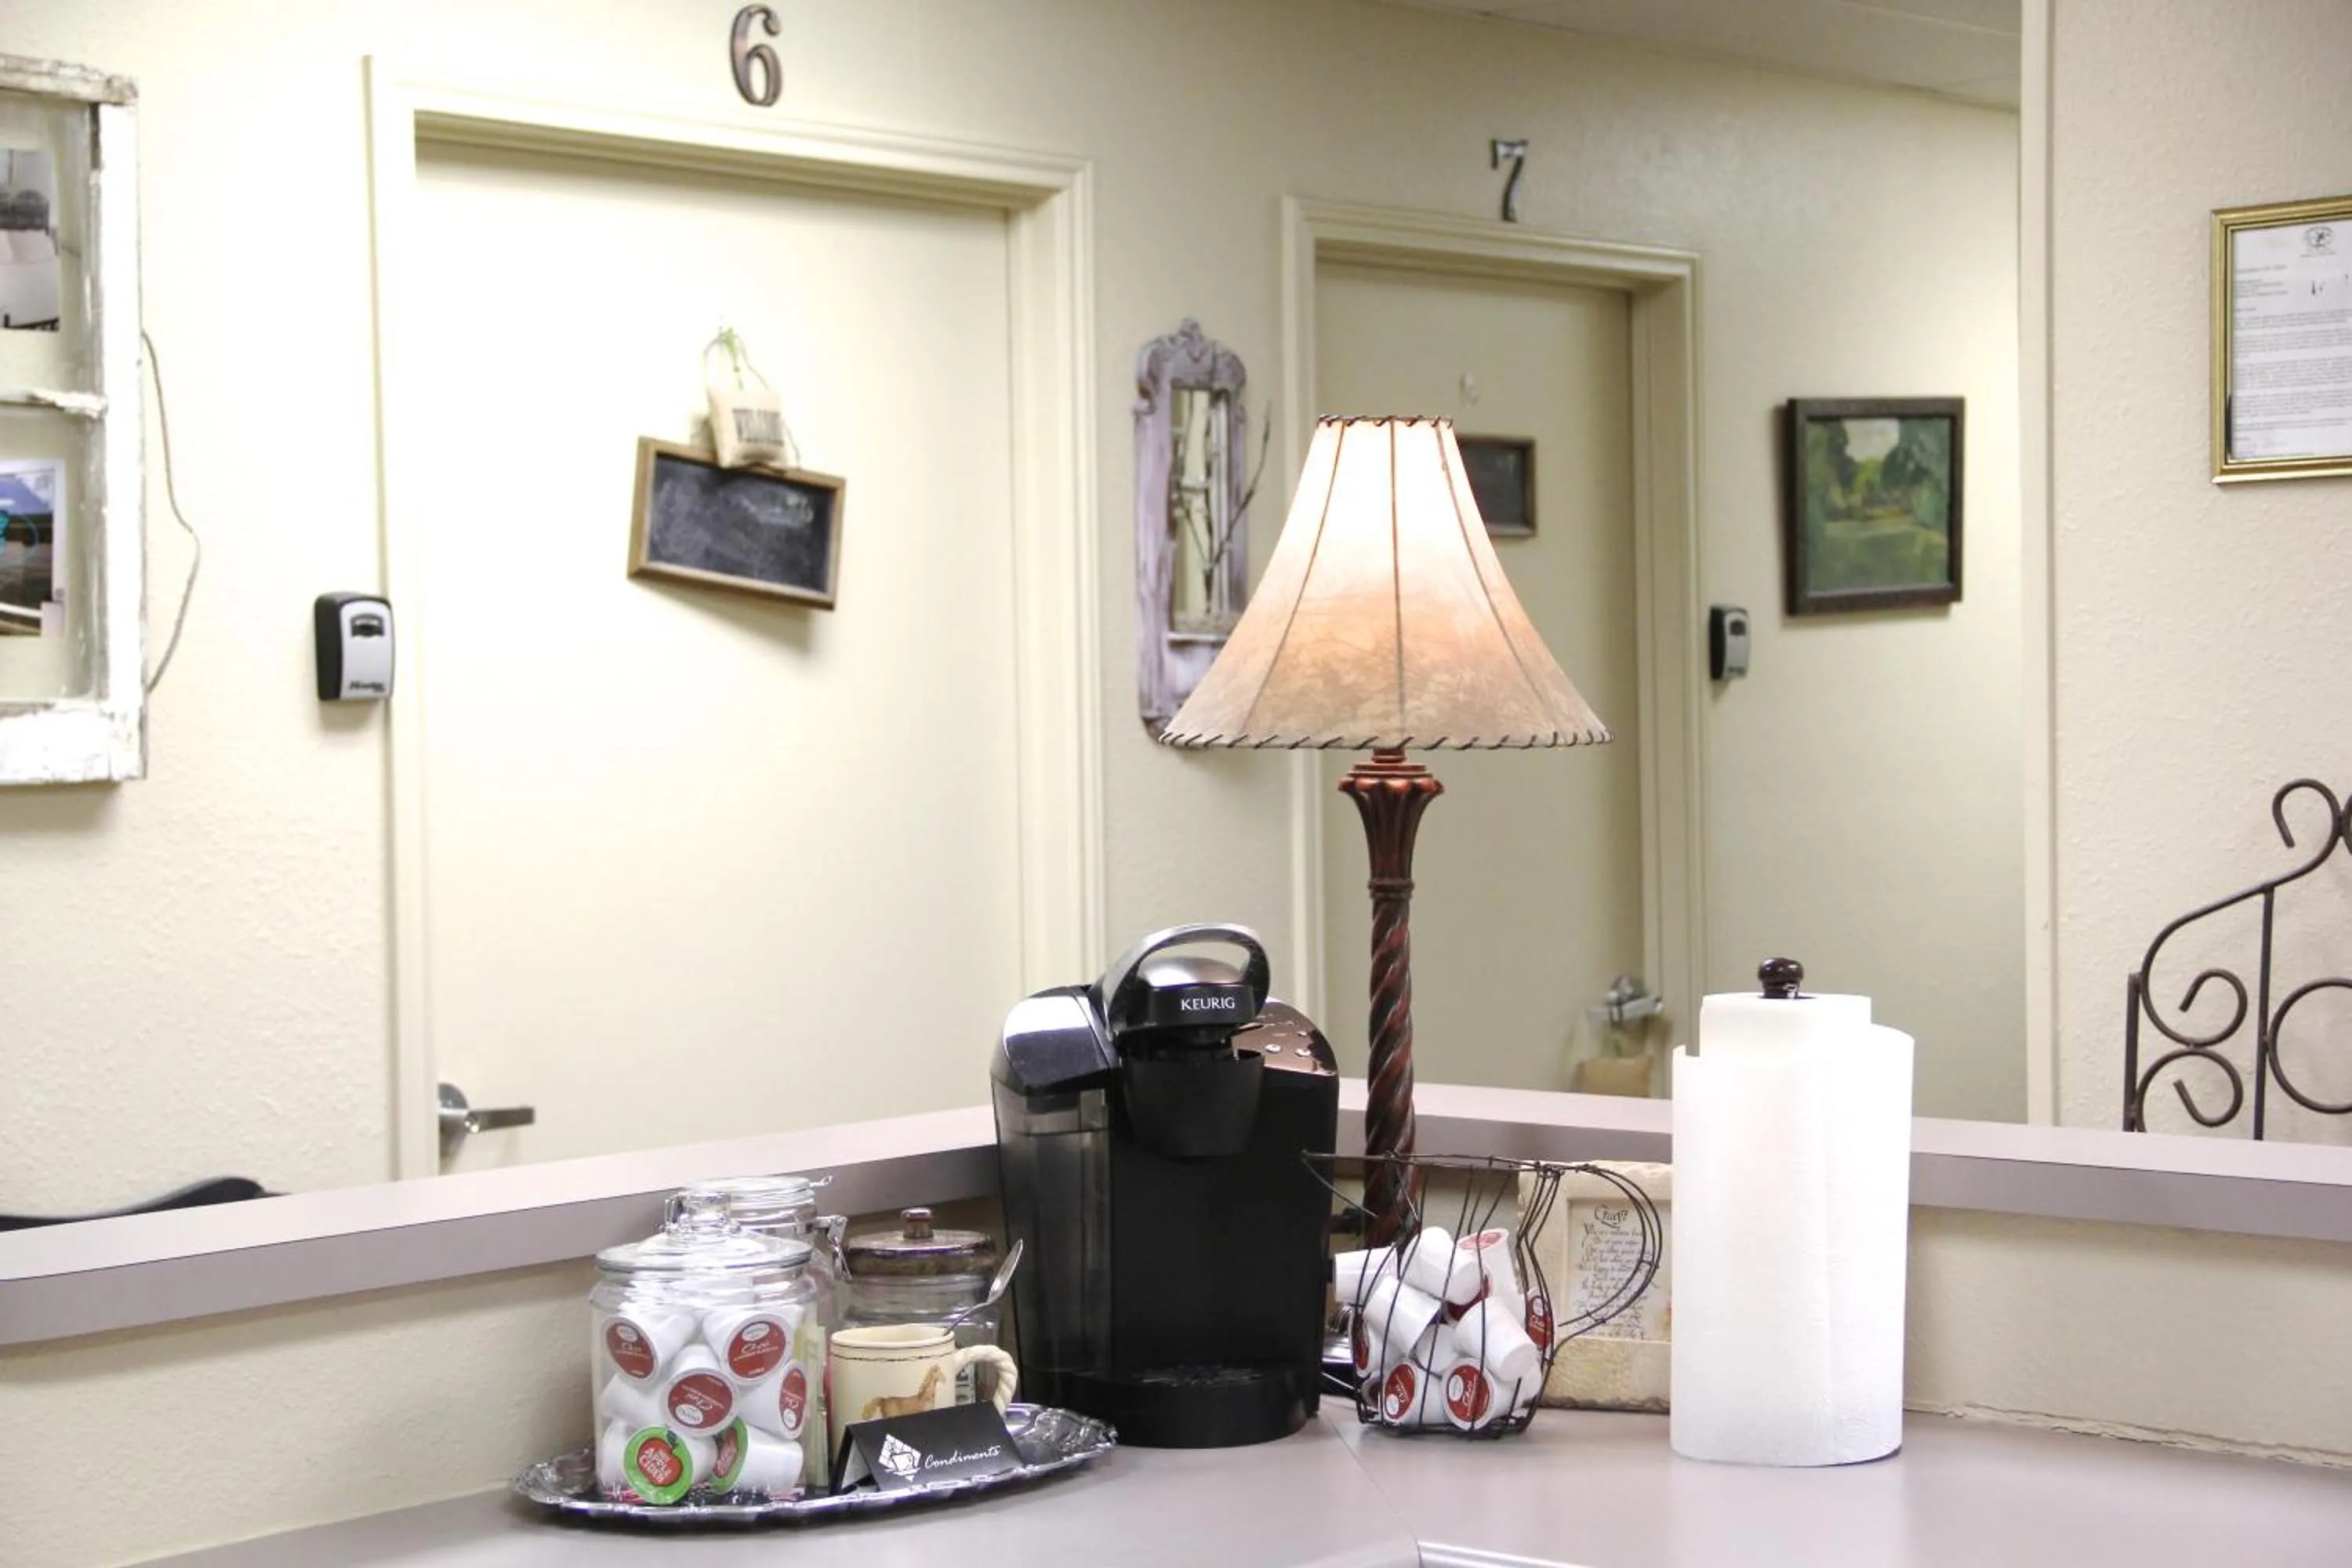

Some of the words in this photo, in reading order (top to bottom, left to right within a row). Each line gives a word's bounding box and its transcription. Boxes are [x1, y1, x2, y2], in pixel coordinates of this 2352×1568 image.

[730, 5, 782, 107] 6
[1490, 139, 1530, 223] 7
[1181, 996, 1236, 1011] KEURIG
[924, 1445, 1001, 1468] Condiments
